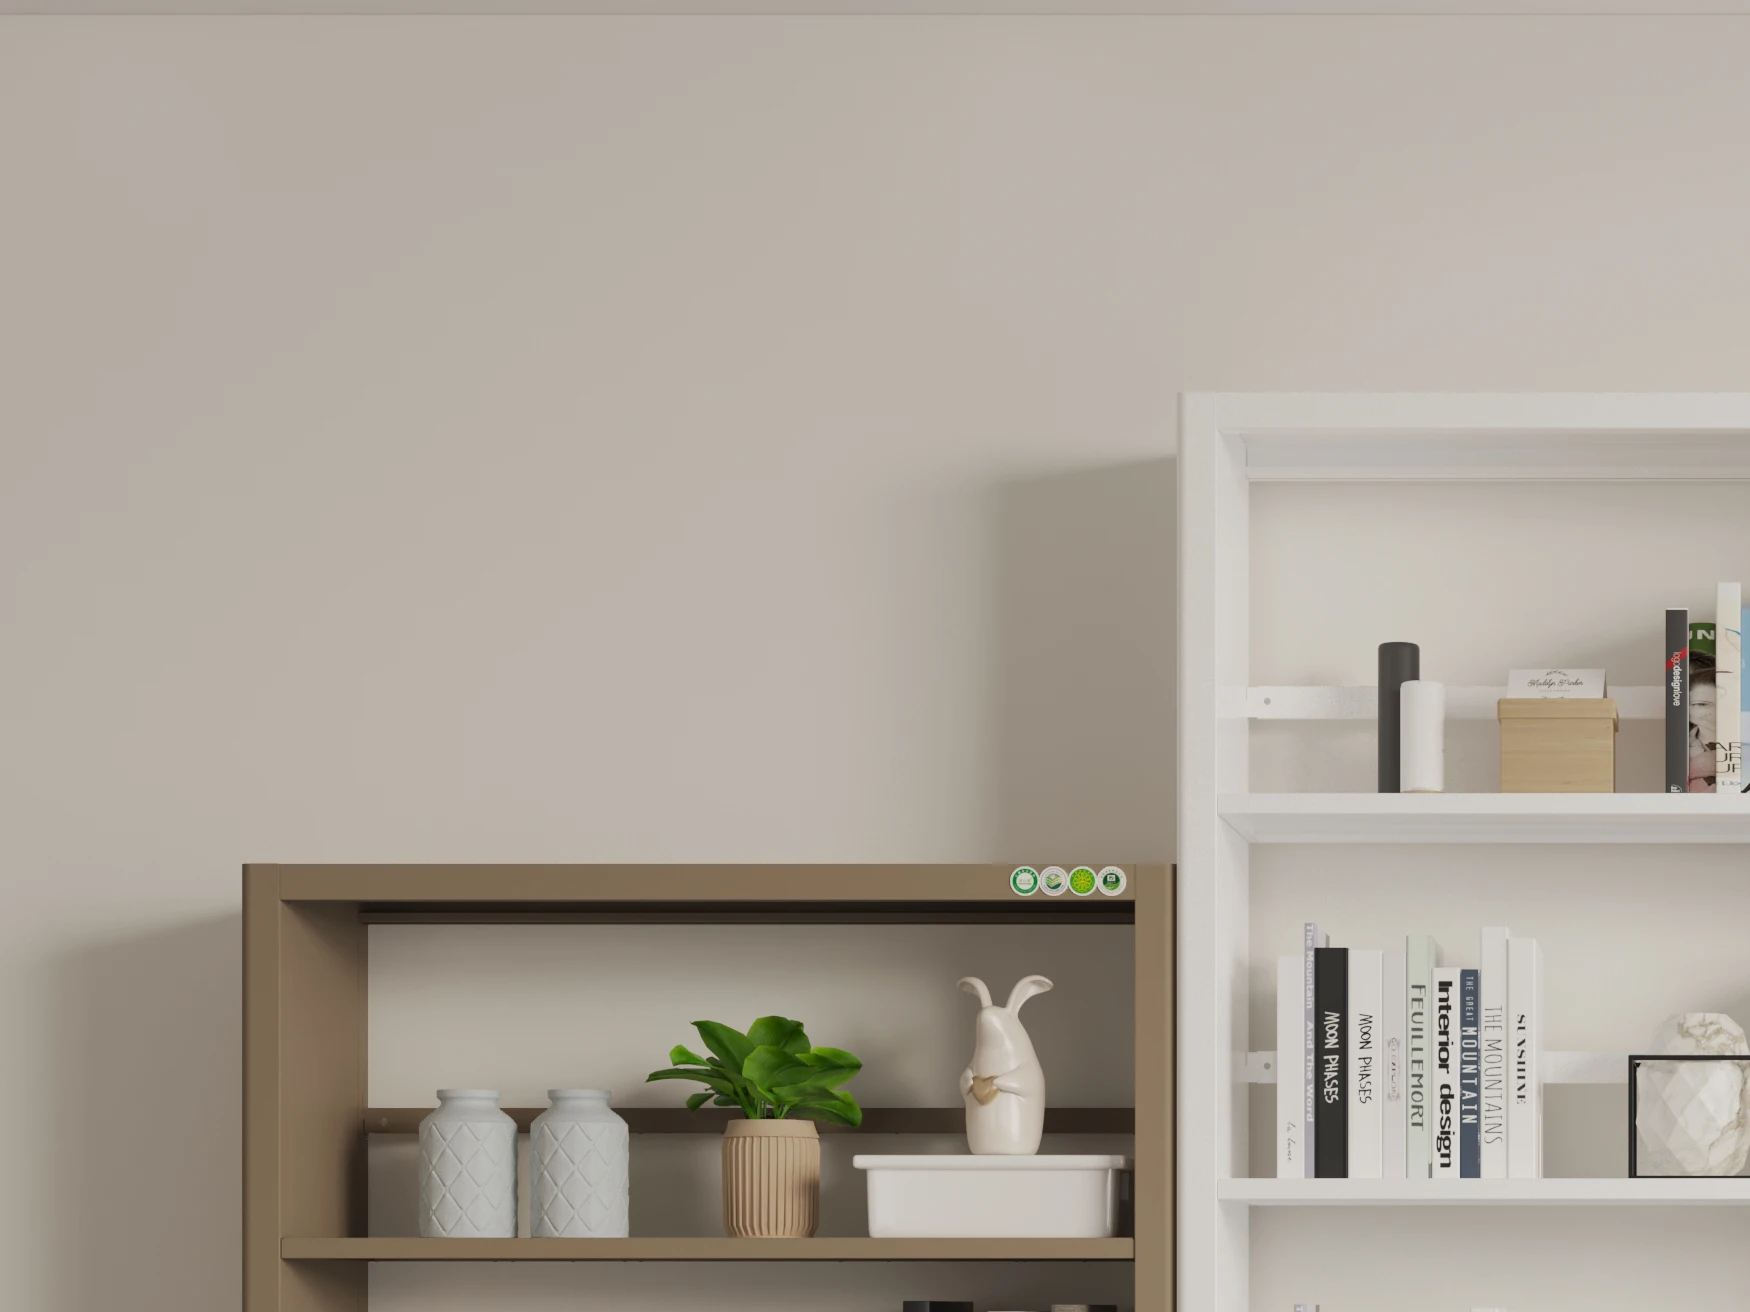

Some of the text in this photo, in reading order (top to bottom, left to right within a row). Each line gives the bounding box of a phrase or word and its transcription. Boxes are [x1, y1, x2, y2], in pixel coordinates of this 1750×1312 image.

[1324, 1012, 1340, 1103] MOON PHASES
[1359, 1014, 1372, 1103] MOON PHASES
[1411, 985, 1426, 1131] FEUILLEMORT
[1437, 981, 1455, 1167] Interior design
[1462, 1027, 1478, 1124] MOUNTAIN
[1484, 1006, 1502, 1144] THE MOUNTAINS
[1517, 1015, 1526, 1105] SUNSHINE
